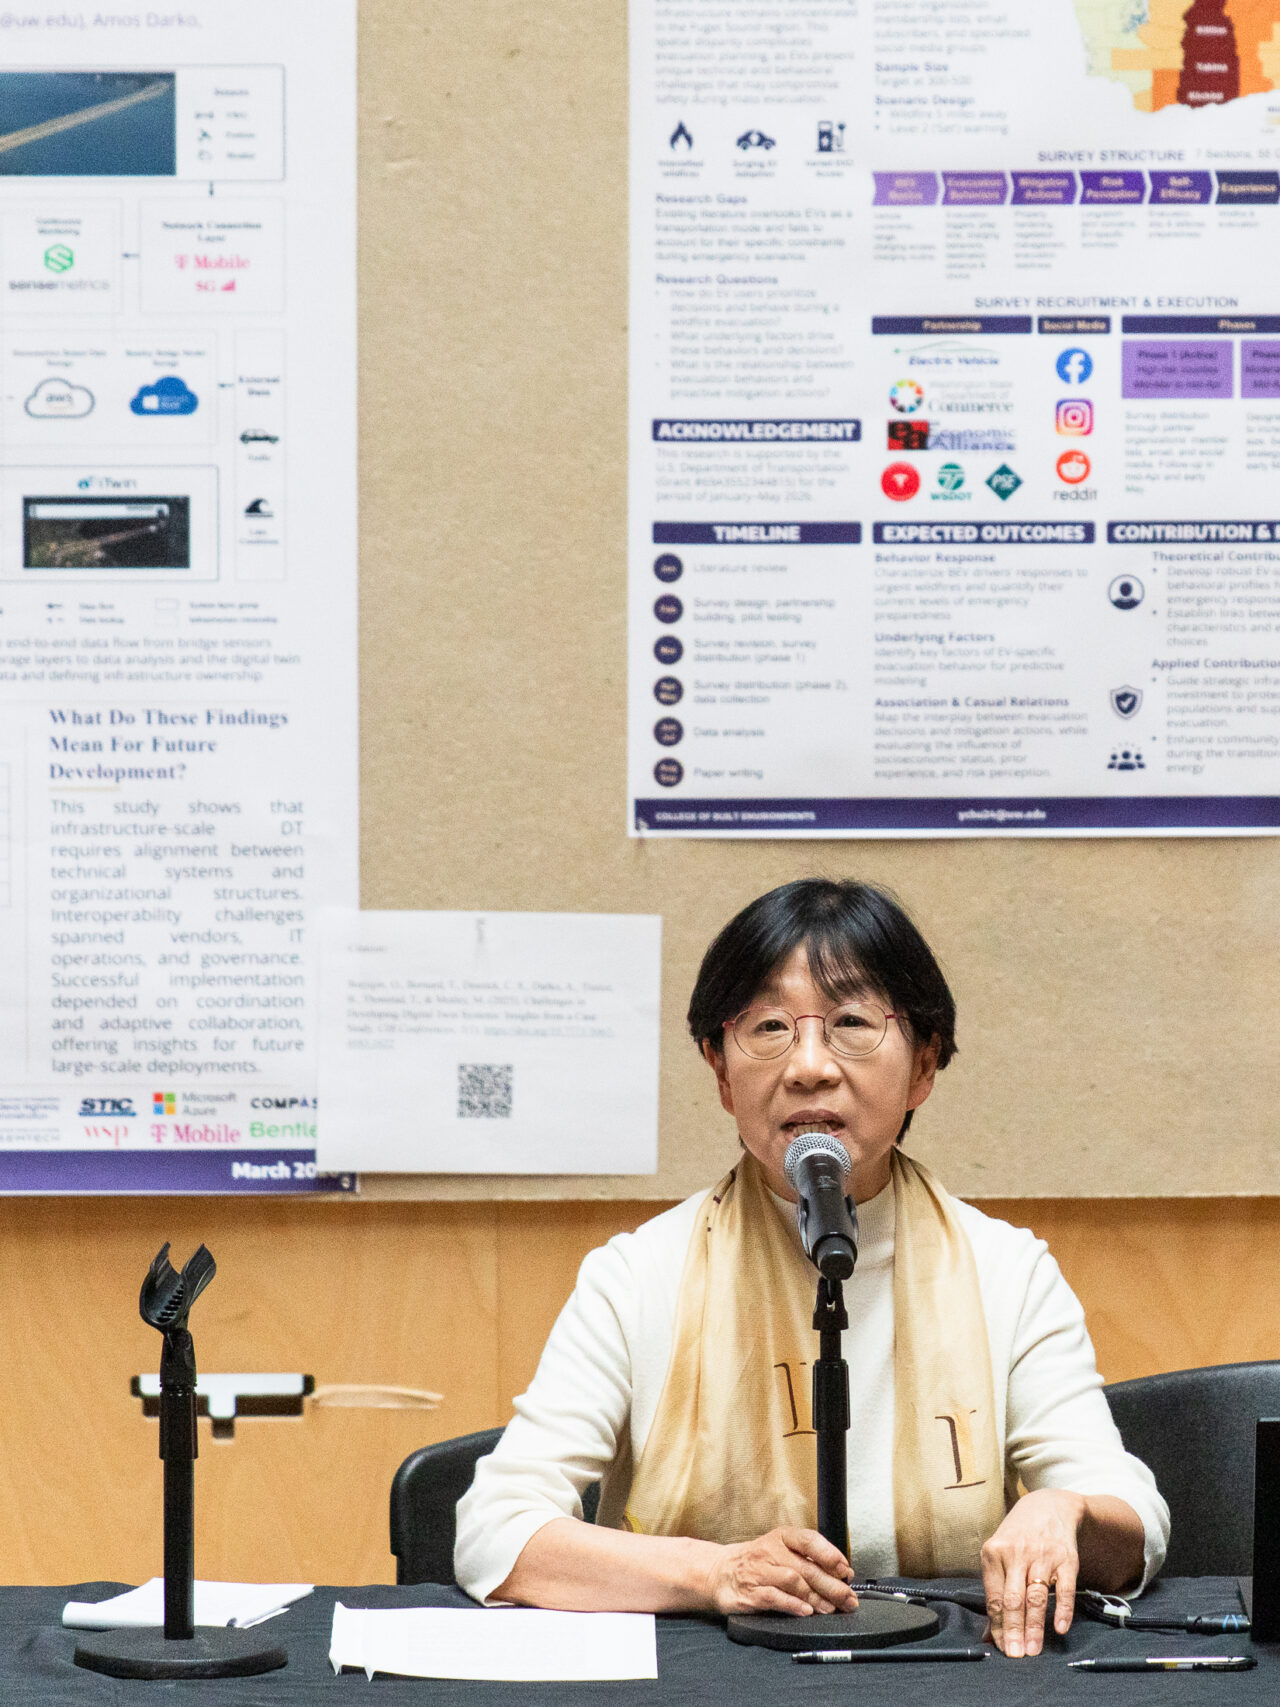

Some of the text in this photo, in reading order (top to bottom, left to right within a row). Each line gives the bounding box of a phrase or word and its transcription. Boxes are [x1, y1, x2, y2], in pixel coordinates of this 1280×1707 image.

[654, 423, 858, 438] ACKNOWLEDGEMENT
[713, 526, 801, 541] TIMELINE
[882, 525, 1086, 541] EXPECTED OUTCOMES
[1112, 524, 1252, 541] CONTRIBUTION
[48, 709, 289, 729] What Do These Findings
[49, 736, 217, 752] Mean For Future
[49, 763, 187, 784] Development?
[51, 799, 304, 818] This study shows that
[50, 820, 303, 836] infrastructure-scale DT
[50, 843, 305, 861] requires alignment between
[50, 864, 305, 882] technical systems and
[50, 886, 173, 905] organizational
[50, 907, 305, 926] Interoperability challenges
[50, 930, 126, 948] spanned
[289, 929, 305, 943] IT
[157, 951, 191, 965] and
[50, 972, 305, 990] Successful implementation
[50, 994, 305, 1012] depended on coordination
[50, 1016, 303, 1034] and adaptive collaboration,
[50, 1037, 305, 1056] offering insights for future
[51, 1059, 143, 1077] large-scale
[248, 1121, 318, 1138] Bentle
[231, 1161, 317, 1180] March 20
